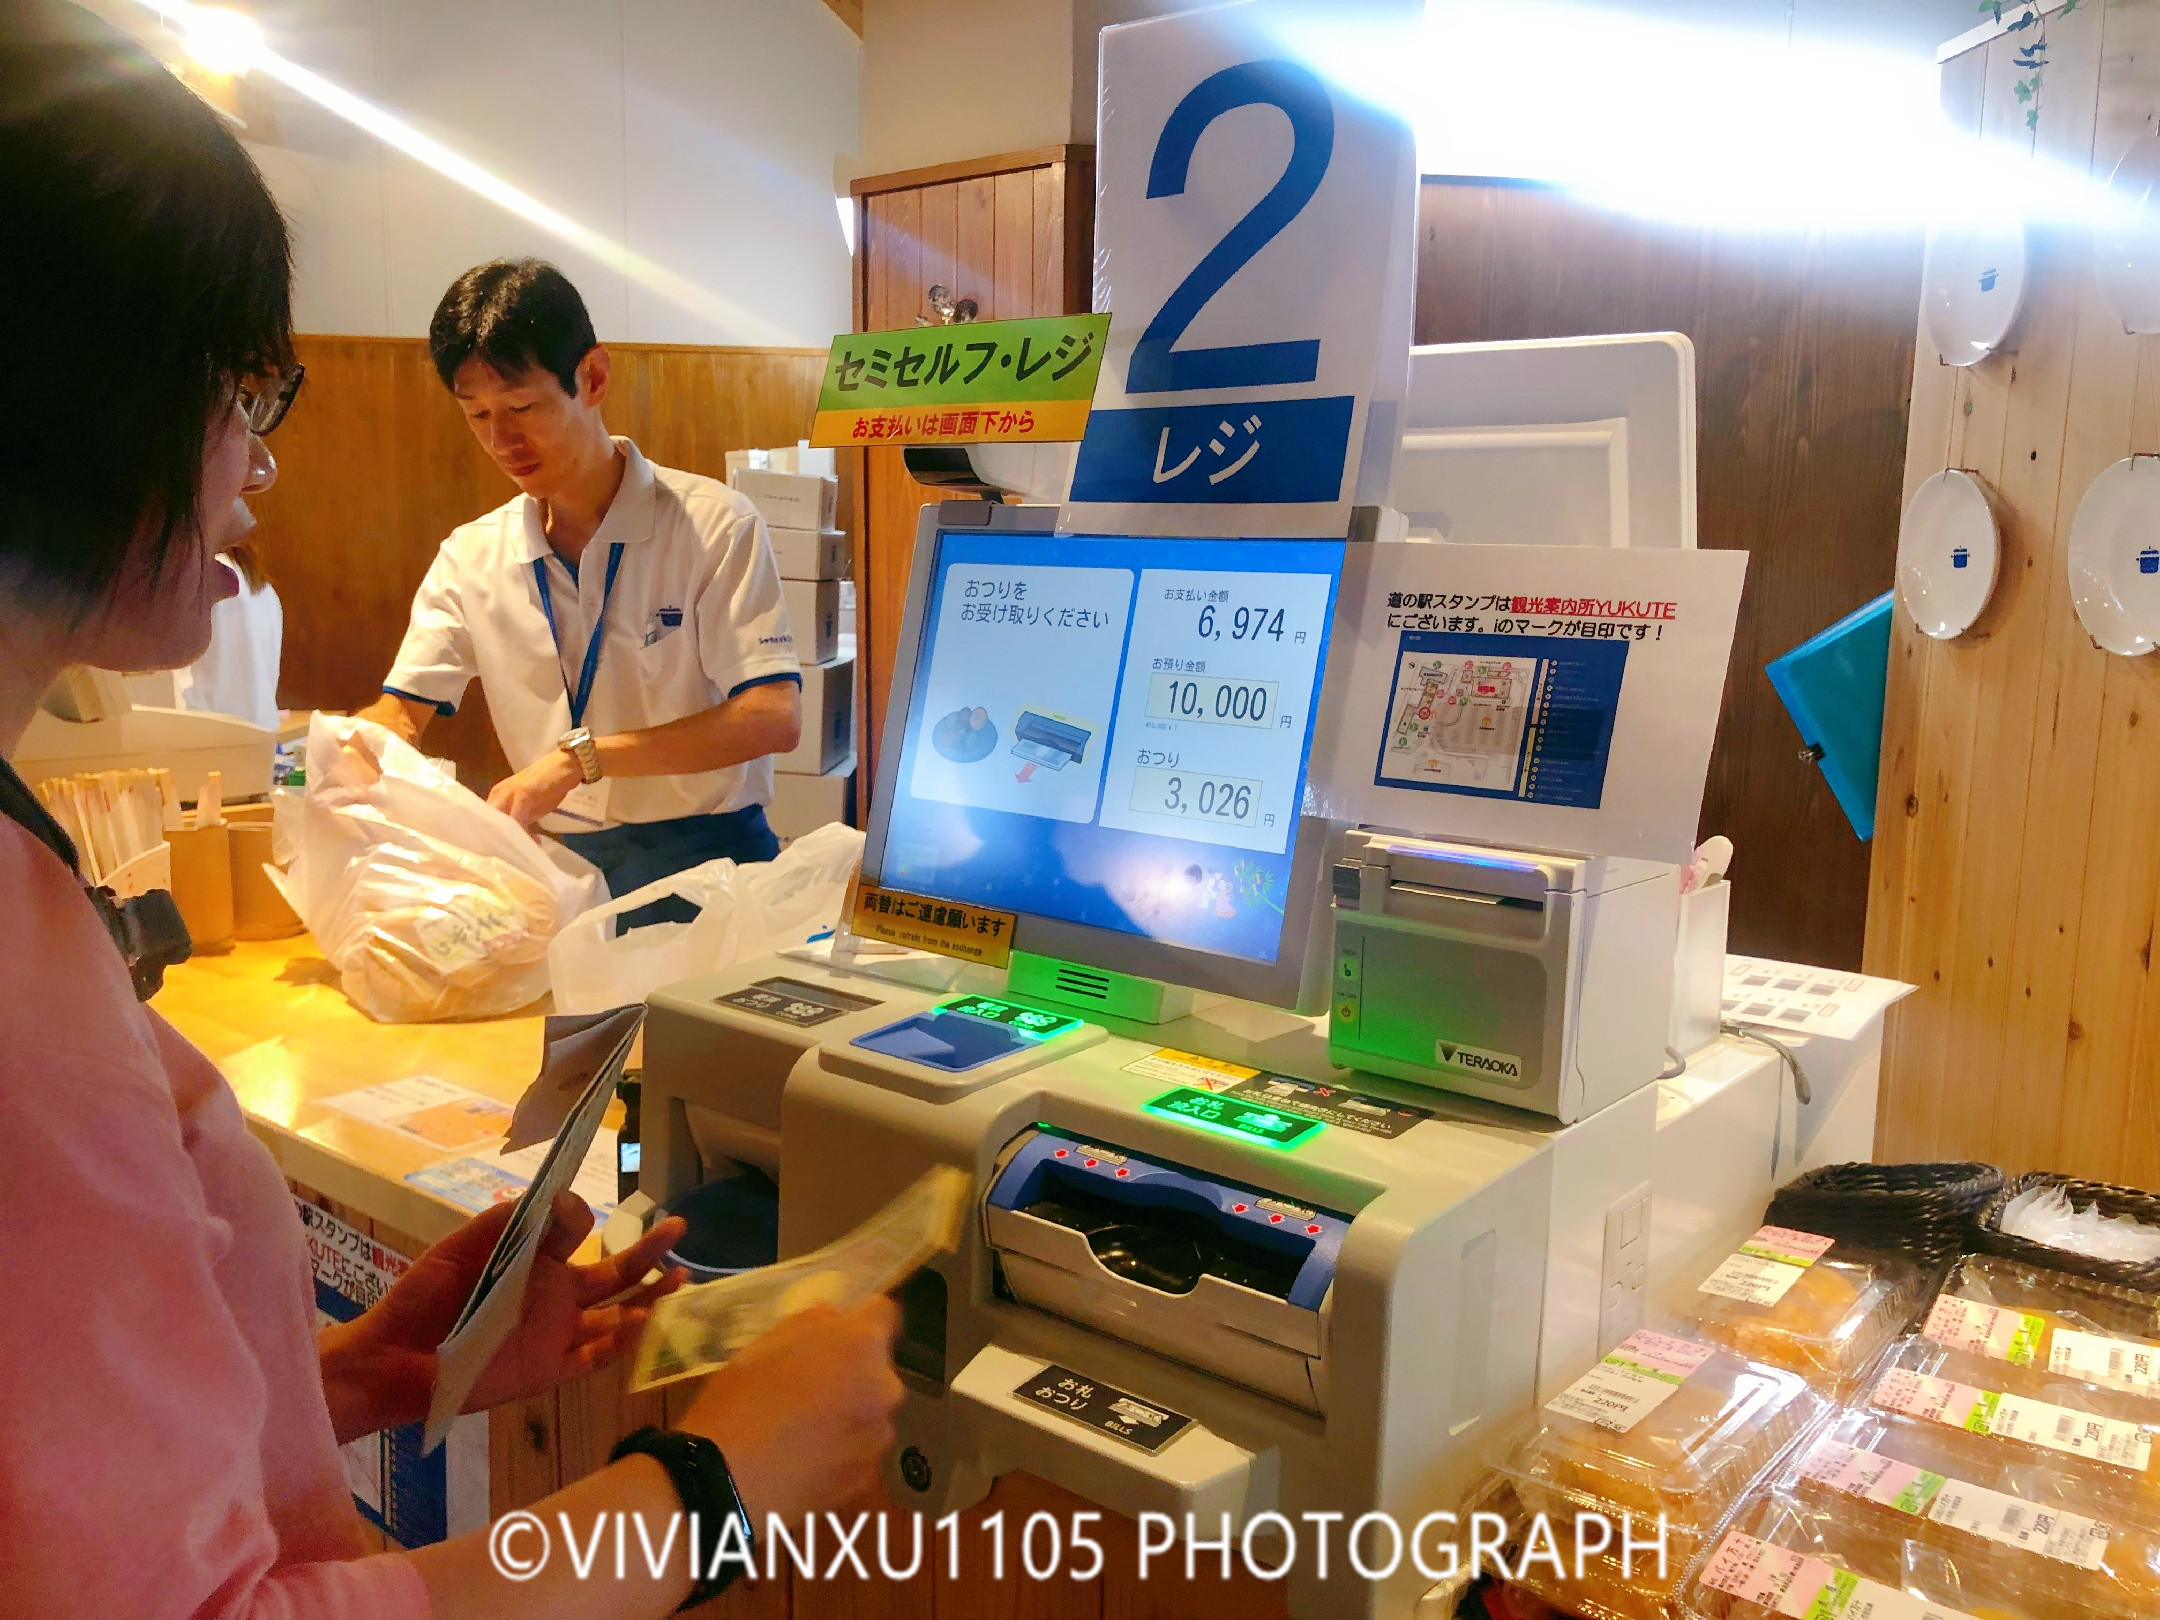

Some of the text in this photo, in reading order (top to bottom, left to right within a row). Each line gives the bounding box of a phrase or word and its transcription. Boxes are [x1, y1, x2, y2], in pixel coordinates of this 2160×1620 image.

[1125, 59, 1336, 394] 2
[834, 331, 1095, 392] セミセルフ・レジ
[852, 409, 1035, 439] お支払いは画面下から
[1151, 414, 1263, 486] レジ
[964, 579, 1027, 600] おつりを
[1164, 588, 1230, 603] お支払い金額
[961, 602, 1109, 628] お受け取りください
[1198, 604, 1307, 644] 6,974 円
[1152, 657, 1207, 673] お預り金額
[1169, 680, 1292, 729] 10,000 円
[1136, 747, 1180, 769] おつり
[1164, 776, 1276, 827] 3,026 円
[863, 892, 1006, 936] 両替はご遠慮願います
[1456, 1051, 1518, 1077] TERAOKA
[1237, 1123, 1265, 1134] BILLS
[1035, 1386, 1089, 1411] おつり
[1057, 1378, 1095, 1399] お札
[1104, 1420, 1134, 1436] BILLS
